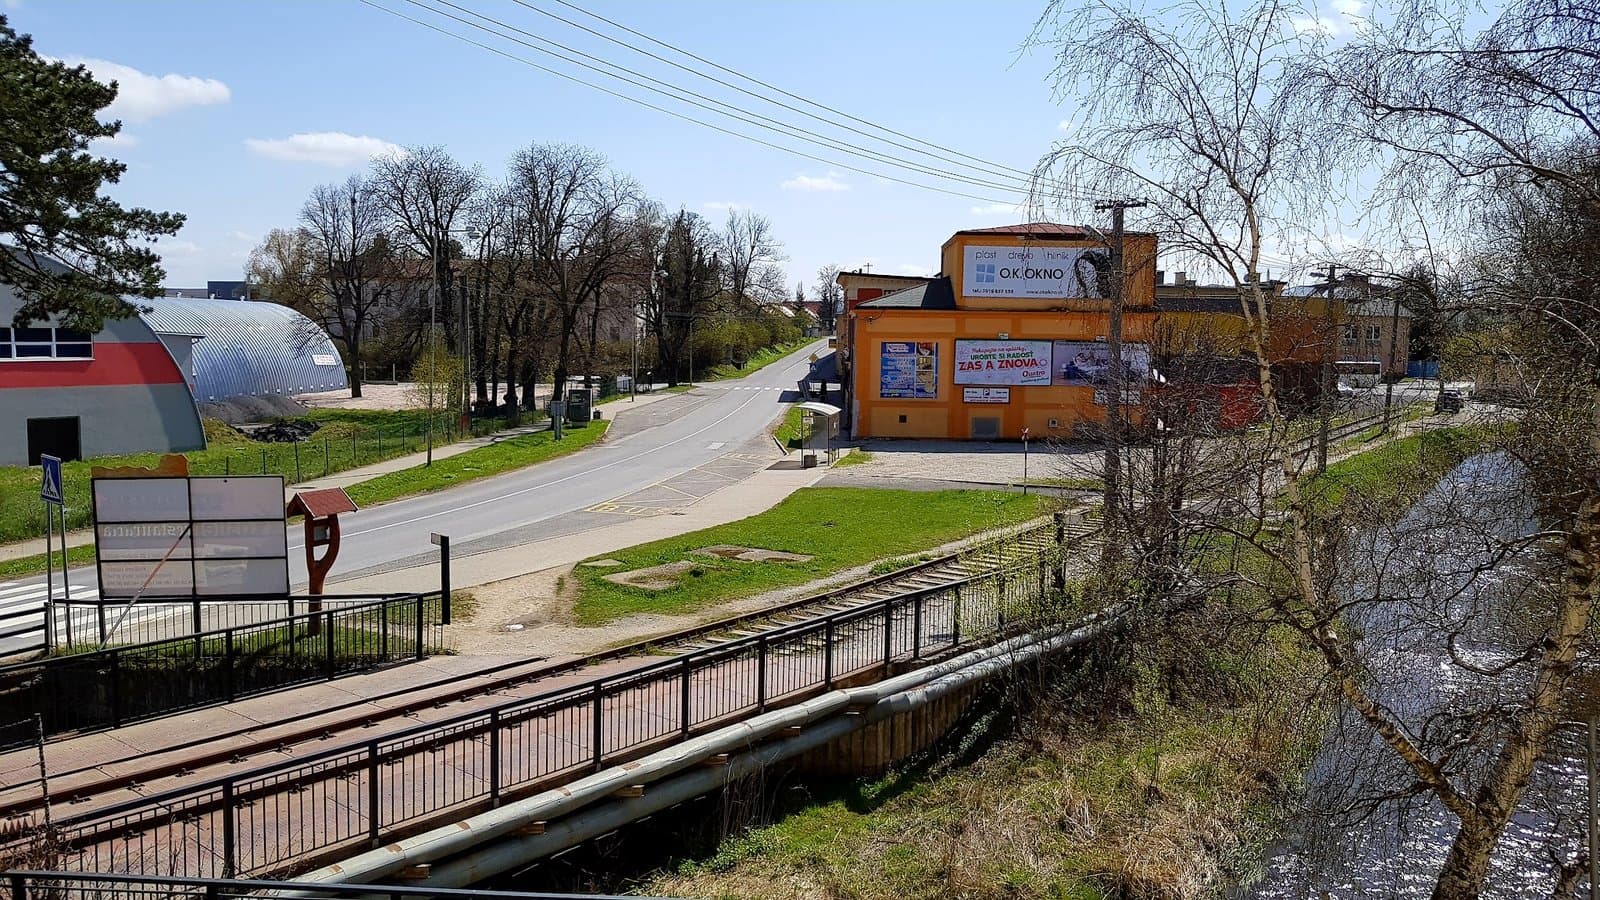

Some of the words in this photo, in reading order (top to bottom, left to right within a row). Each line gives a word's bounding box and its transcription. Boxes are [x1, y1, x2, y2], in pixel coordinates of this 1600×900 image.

[975, 250, 997, 260] plast
[1025, 268, 1064, 280] OKNO
[970, 353, 997, 361] UROBTE
[999, 352, 1005, 360] SI
[958, 360, 982, 371] ZAS
[985, 360, 993, 370] A
[998, 358, 1039, 369] ZNOVA
